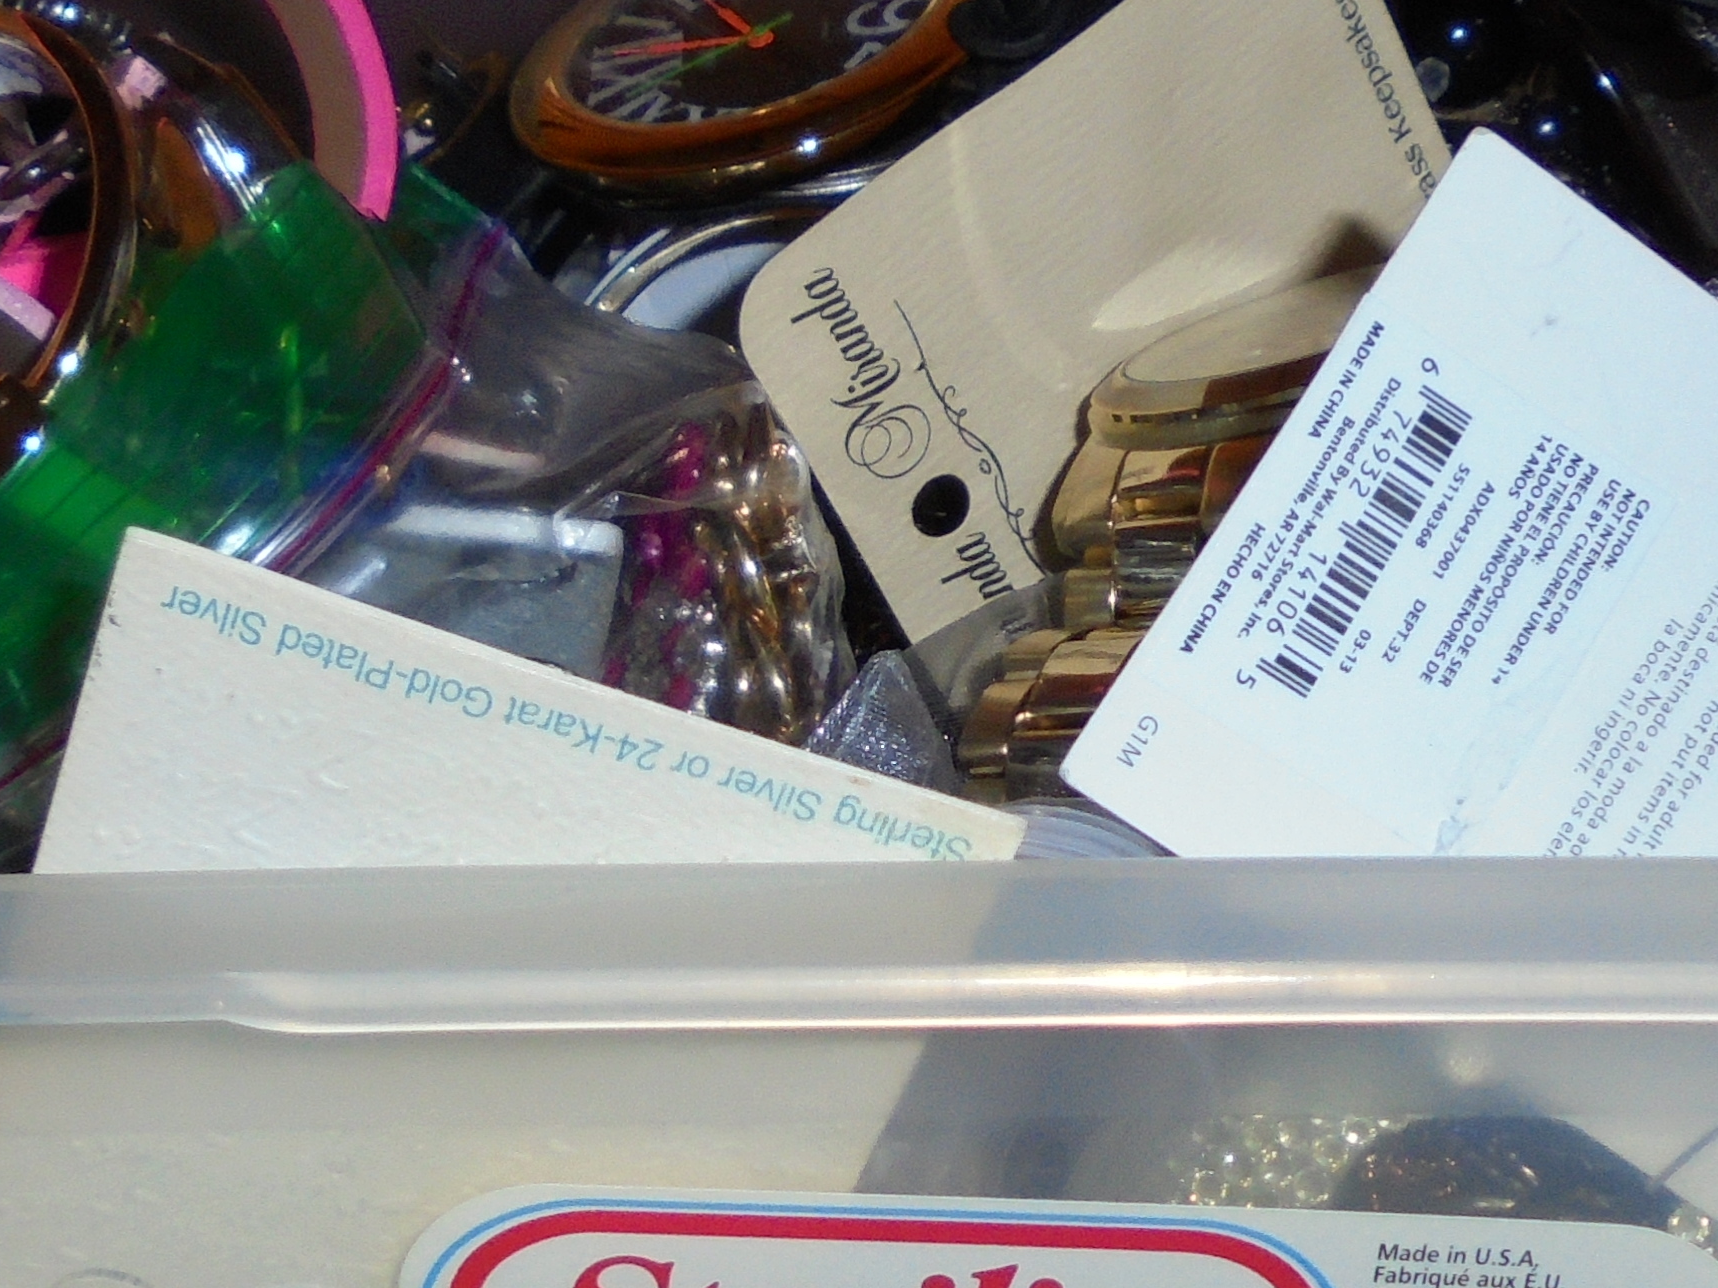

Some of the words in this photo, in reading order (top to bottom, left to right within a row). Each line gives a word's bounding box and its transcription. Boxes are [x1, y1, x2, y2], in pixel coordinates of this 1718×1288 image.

[1350, 321, 1385, 370] MADE
[1421, 357, 1440, 376] 6
[790, 267, 931, 479] Miranda
[1338, 369, 1357, 389] IN
[1308, 389, 1344, 438] CHINA
[1343, 377, 1402, 466] Distributed
[1293, 415, 1356, 505] Bentonville,
[1348, 410, 1413, 498] 74932
[1534, 435, 1553, 454] 14
[1563, 452, 1584, 479] NO
[1330, 464, 1350, 486] By
[1508, 453, 1540, 499] AÑOS
[1530, 443, 1569, 499] USADO
[1596, 479, 1622, 511] USE
[1279, 507, 1300, 533] AR
[1288, 488, 1338, 558] Wal-Mart
[1415, 463, 1471, 549] 551140368
[1508, 499, 1536, 534] POR
[1531, 463, 1600, 566] PRECAUCIÓN:
[1535, 480, 1569, 525] TIENE
[1584, 509, 1604, 533] BY
[1611, 488, 1637, 524] NOT
[1226, 522, 1266, 579] HECHO
[1432, 481, 1495, 580] ADX0437001
[1523, 524, 1543, 542] EL
[1603, 499, 1650, 569] CAUTION:
[1251, 532, 1286, 582] 72716
[1479, 533, 1516, 585] NIÑOS
[1537, 533, 1589, 611] CHILDREN
[1564, 523, 1616, 601] INTENDED
[1210, 579, 1232, 604] EN
[1254, 558, 1294, 608] Stores,
[1266, 552, 1328, 636] 14106
[1471, 544, 1530, 634] PROPÓSITO
[159, 585, 267, 646] Silver
[1179, 603, 1217, 653] CHINA
[1237, 612, 1262, 638] Inc.
[1381, 598, 1427, 663] DEPT.32
[1434, 584, 1485, 661] MENORES
[1503, 611, 1544, 666] UNDER
[1543, 601, 1570, 635] FOR
[1663, 618, 1685, 636] la
[1339, 629, 1372, 674] 03-13
[1456, 633, 1477, 657] DE
[1632, 639, 1671, 685] boca
[275, 623, 493, 718] Gold-Plated
[1236, 668, 1257, 689] 5
[1419, 659, 1440, 684] DE
[1437, 656, 1463, 688] SER
[1645, 647, 1709, 738] destinado
[1618, 687, 1637, 708] ni
[1636, 689, 1662, 717] No
[502, 695, 665, 771] 24-Karat
[1116, 715, 1159, 768] G1M
[1573, 709, 1626, 774] ingerir.
[1591, 720, 1639, 789] colocar
[1635, 740, 1649, 753] a
[1671, 733, 1699, 770] put
[669, 750, 710, 779] or
[1621, 756, 1643, 774] la
[1677, 770, 1703, 800] for
[716, 766, 822, 822] Silver
[1571, 790, 1598, 819] los
[1586, 777, 1626, 830] moda
[1637, 771, 1675, 824] items
[833, 794, 972, 862] Sterling
[1623, 825, 1642, 845] in
[1643, 800, 1680, 850] adult
[1377, 1243, 1440, 1265] Made
[1446, 1246, 1467, 1265] in
